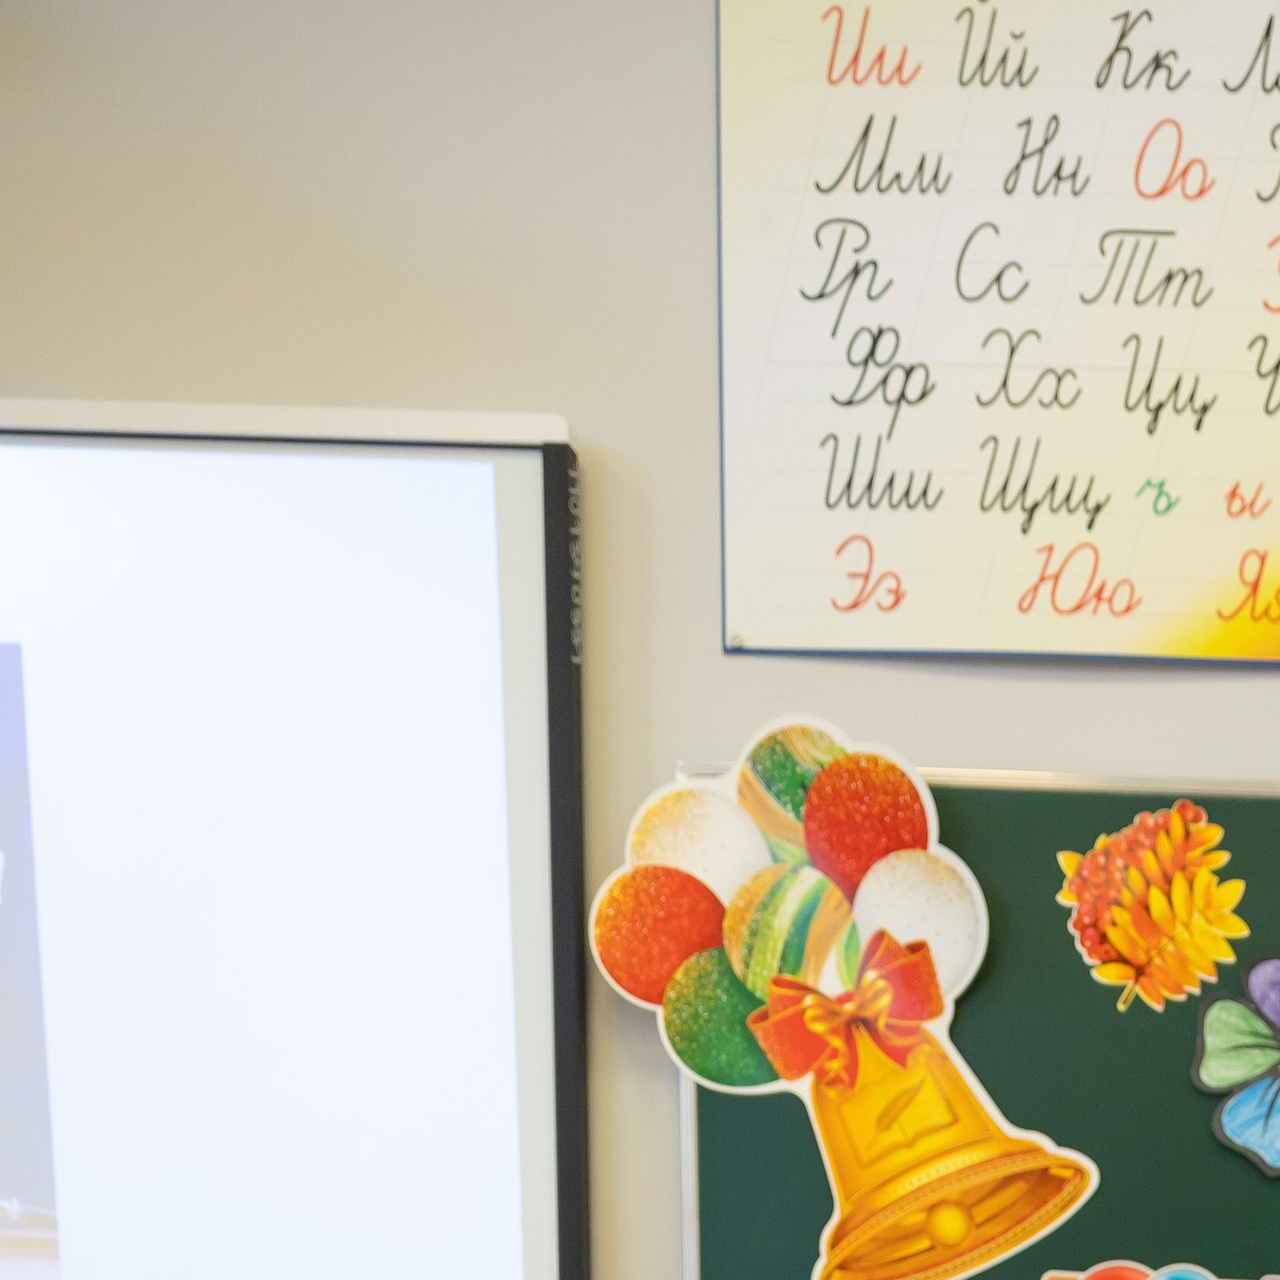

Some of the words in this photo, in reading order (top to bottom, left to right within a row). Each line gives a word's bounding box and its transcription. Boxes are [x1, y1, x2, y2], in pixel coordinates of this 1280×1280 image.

[822, 4, 921, 87] Ии
[954, 0, 1040, 90] Йй
[1094, 8, 1192, 92] Кк
[814, 112, 952, 197] Мм
[1002, 112, 1091, 198] Нн
[1133, 117, 1216, 201] Оо
[799, 216, 894, 339] Рр
[954, 222, 1030, 304] Сс
[1079, 228, 1214, 308] Тт
[829, 324, 936, 442] Фф
[974, 327, 1083, 410] Хх
[1121, 333, 1218, 437] Цц
[819, 432, 944, 511] Шш
[978, 434, 1112, 536] Щщ
[1226, 480, 1272, 520] ы
[831, 534, 908, 613] Ээ
[1016, 541, 1142, 619] Юю
